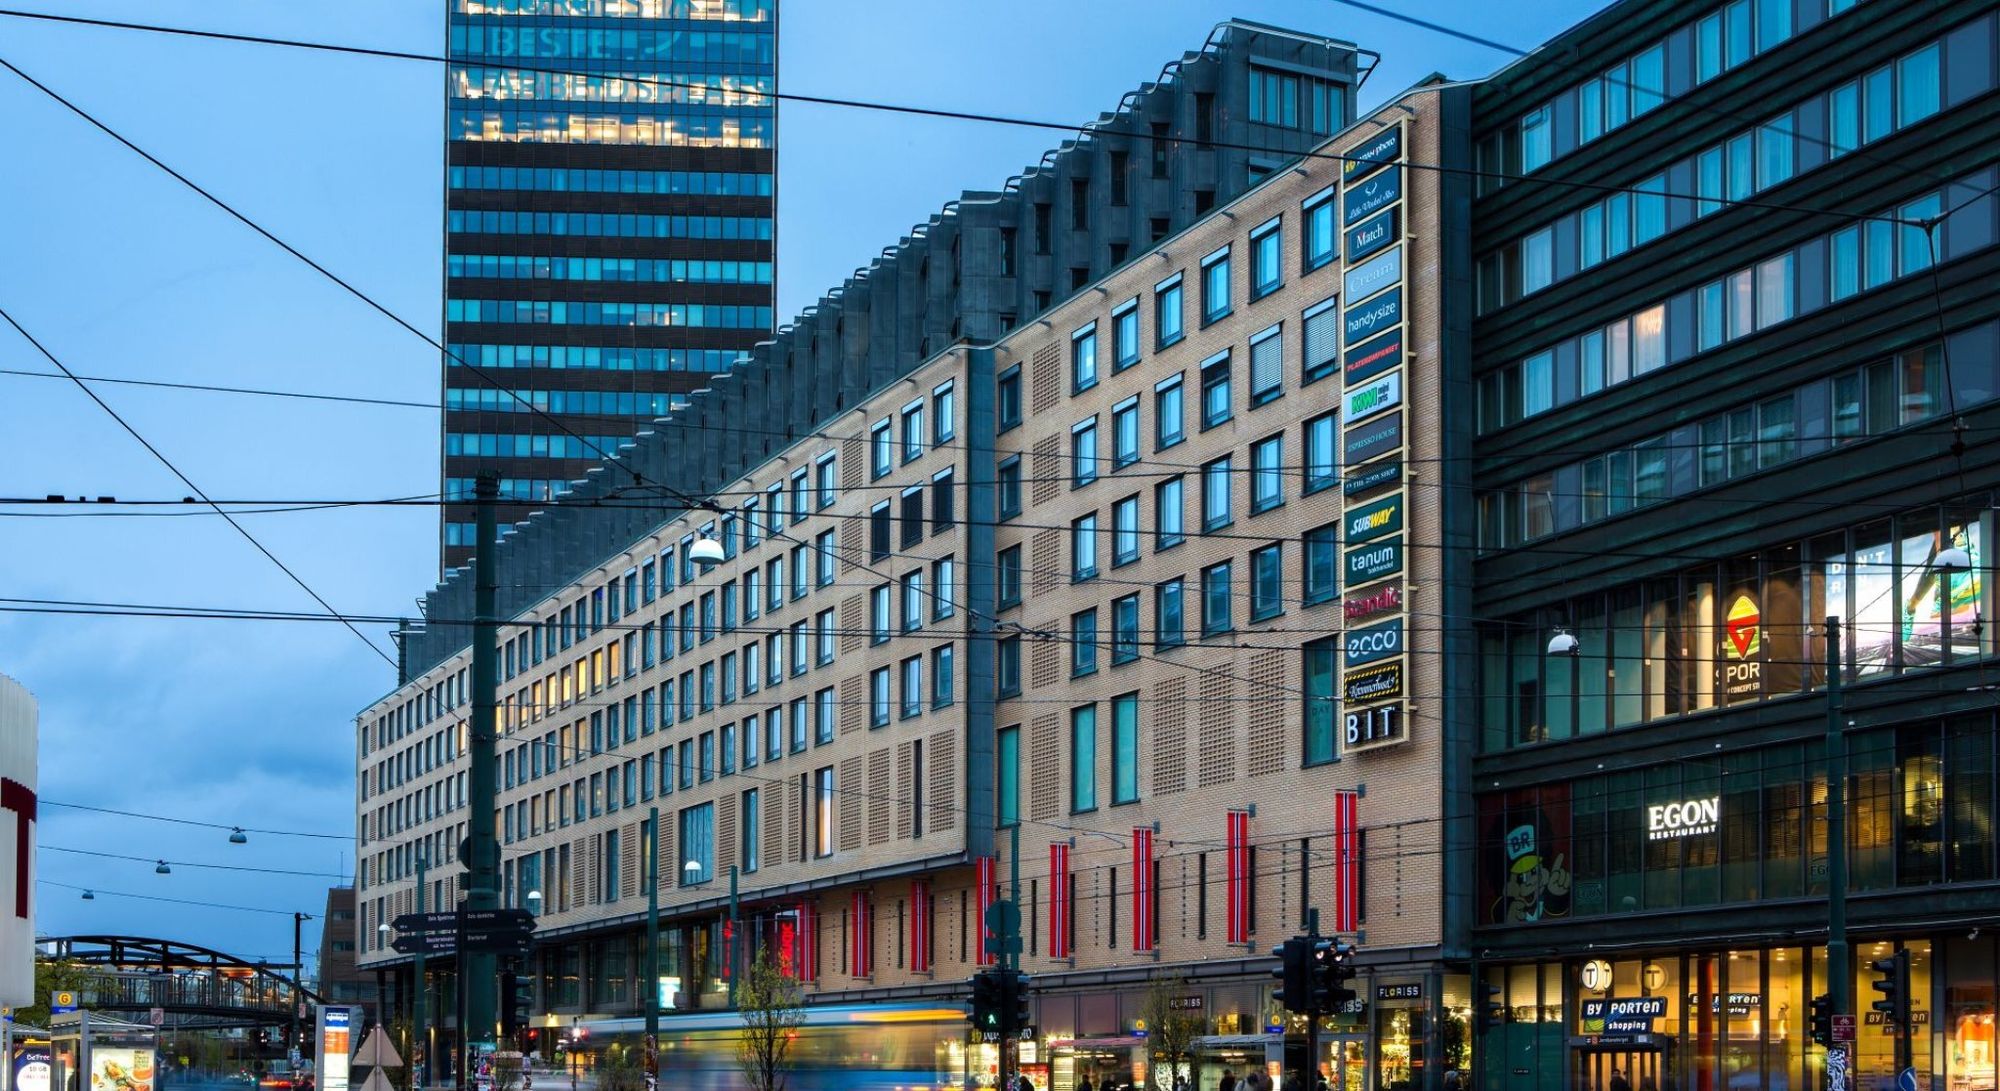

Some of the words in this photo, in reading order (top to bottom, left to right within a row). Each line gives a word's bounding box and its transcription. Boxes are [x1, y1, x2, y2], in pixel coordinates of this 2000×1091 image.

[491, 28, 612, 57] BESTE
[1357, 223, 1383, 249] Match
[1348, 302, 1396, 333] handysize
[1352, 387, 1377, 415] KIWI
[1350, 506, 1395, 536] SUBWAY
[1352, 547, 1393, 571] tanum
[1831, 551, 1885, 574] DN'T
[1348, 630, 1396, 658] ecco
[1346, 706, 1395, 744] BIT
[1649, 796, 1719, 831] EGON
[1511, 831, 1530, 853] BR
[1650, 825, 1716, 840] RESTAURANT
[1586, 968, 1596, 985] T
[1646, 969, 1660, 987] T
[1379, 986, 1419, 997] FLORISS
[1608, 1020, 1646, 1031] shopping
